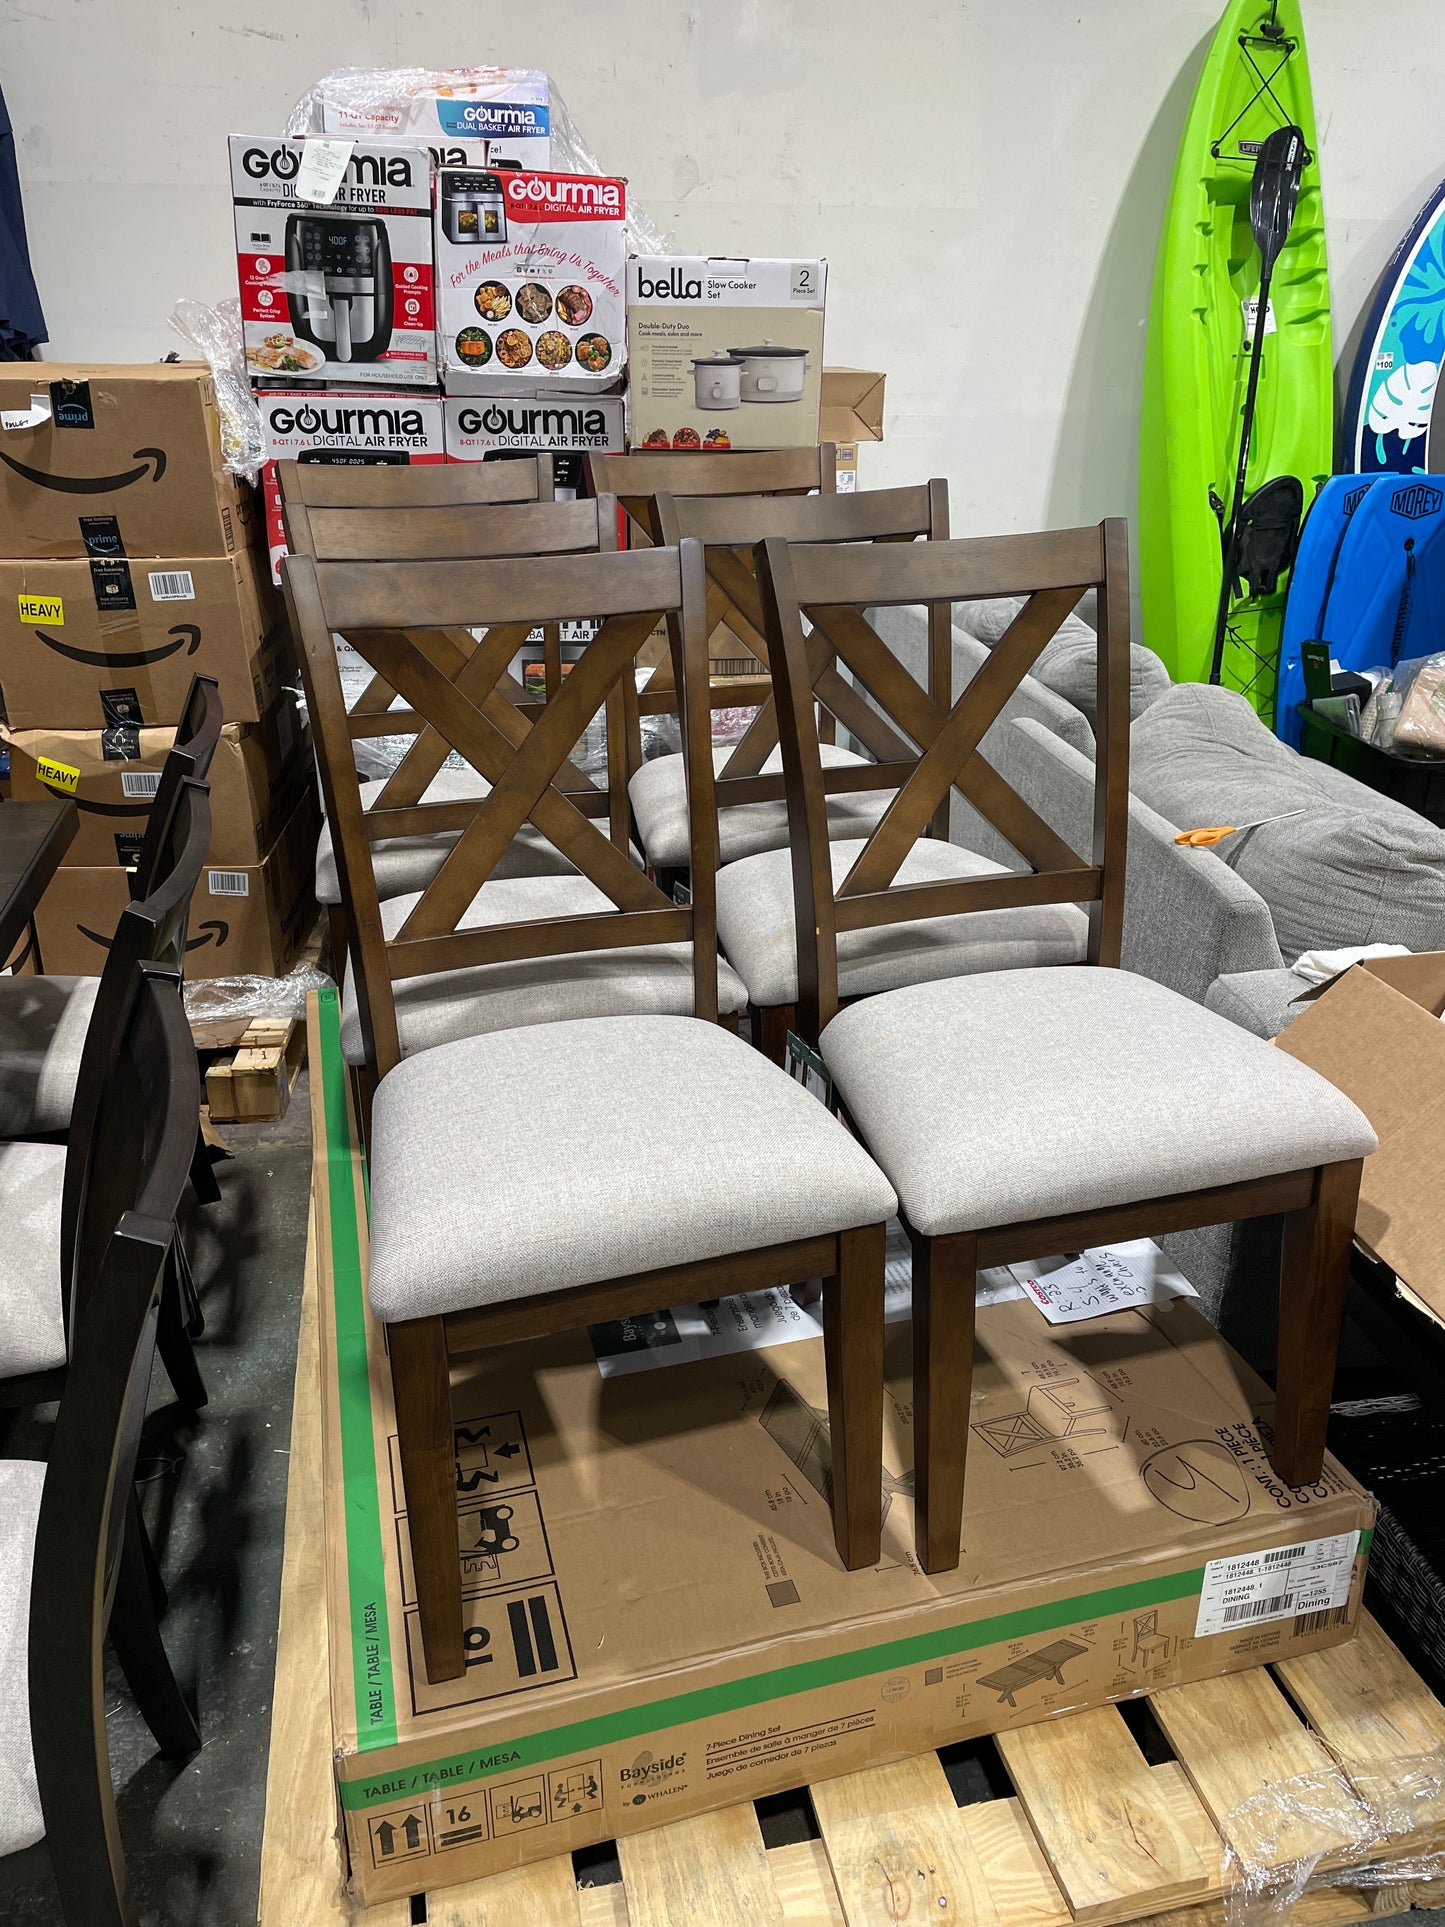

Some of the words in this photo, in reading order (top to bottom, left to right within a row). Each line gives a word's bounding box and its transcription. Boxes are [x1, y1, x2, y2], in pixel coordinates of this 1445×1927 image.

[365, 113, 398, 123] Capacity
[464, 106, 536, 124] Gourmia
[456, 122, 476, 130] DUAL
[478, 123, 506, 132] BASKET
[522, 126, 546, 134] FRYER
[1242, 143, 1262, 153] LIFET
[242, 144, 413, 187] Gomia
[351, 187, 386, 204] FRYER
[508, 176, 619, 206] Gourmia
[267, 200, 296, 209] FryForce
[312, 202, 348, 212] Technology
[544, 202, 576, 212] DIGITAL
[578, 205, 592, 214] AIR
[594, 206, 620, 216] FRYER
[450, 272, 466, 288] For
[466, 258, 480, 276] the
[482, 244, 512, 266] Meals
[514, 242, 535, 256] that
[538, 243, 568, 266] Bring
[569, 252, 582, 266] Us
[582, 260, 620, 297] Together
[800, 270, 810, 286] 2
[638, 266, 702, 300] bella
[708, 280, 726, 289] Slow
[728, 280, 756, 290] Cooker
[708, 290, 720, 299] Set
[638, 322, 676, 331] Double-Duty
[58, 411, 88, 424] prime
[270, 403, 424, 436] Gourmia
[458, 404, 606, 435] Gourmia
[272, 438, 289, 446] 8-QT
[294, 438, 305, 446] 7.6
[313, 435, 362, 446] DIGITAL
[364, 436, 384, 446] AIR
[388, 436, 428, 447] FRYER
[460, 438, 476, 446] 8-QT
[480, 438, 490, 446] 7.6
[498, 436, 546, 446] DIGITAL
[548, 436, 568, 446] AIR
[571, 436, 609, 447] FRYER
[1393, 487, 1440, 517] MOREY
[88, 534, 118, 545] prime
[20, 602, 61, 618] HEAVY
[571, 630, 590, 640] AIR
[38, 764, 77, 786] HEAVY
[726, 1298, 748, 1332] Ensemble
[790, 1311, 800, 1321] de
[1215, 1426, 1248, 1458] PIECE
[1232, 1423, 1262, 1452] PIÈCE
[1256, 1470, 1292, 1508] CONT.
[1226, 1559, 1260, 1572] 1812448
[1222, 1594, 1250, 1604] DINING
[1298, 1597, 1330, 1610] Dining
[364, 1602, 378, 1634] MESA
[366, 1644, 380, 1679] TABLE
[369, 1690, 384, 1726] TABLE
[706, 1737, 737, 1750] 7-Piece
[738, 1729, 766, 1742] Dining
[768, 1724, 781, 1734] Set
[706, 1749, 748, 1766] Ensemble
[749, 1744, 762, 1754] de
[763, 1739, 782, 1750] salle
[784, 1736, 791, 1744] à
[792, 1728, 826, 1742] manger
[827, 1724, 838, 1733] de
[840, 1722, 846, 1730] 7
[846, 1715, 874, 1728] pièces
[620, 1754, 685, 1782] Bayside
[706, 1766, 734, 1780] Juego
[736, 1763, 748, 1772] de
[749, 1753, 790, 1768] comedor
[790, 1748, 802, 1757] de
[804, 1746, 810, 1754] 7
[810, 1739, 837, 1753] piezas
[363, 1779, 406, 1799] TABLE
[422, 1764, 464, 1784] TABLE
[480, 1750, 522, 1770] MESA
[648, 1785, 684, 1800] WHALEN
[445, 1806, 472, 1824] 16
